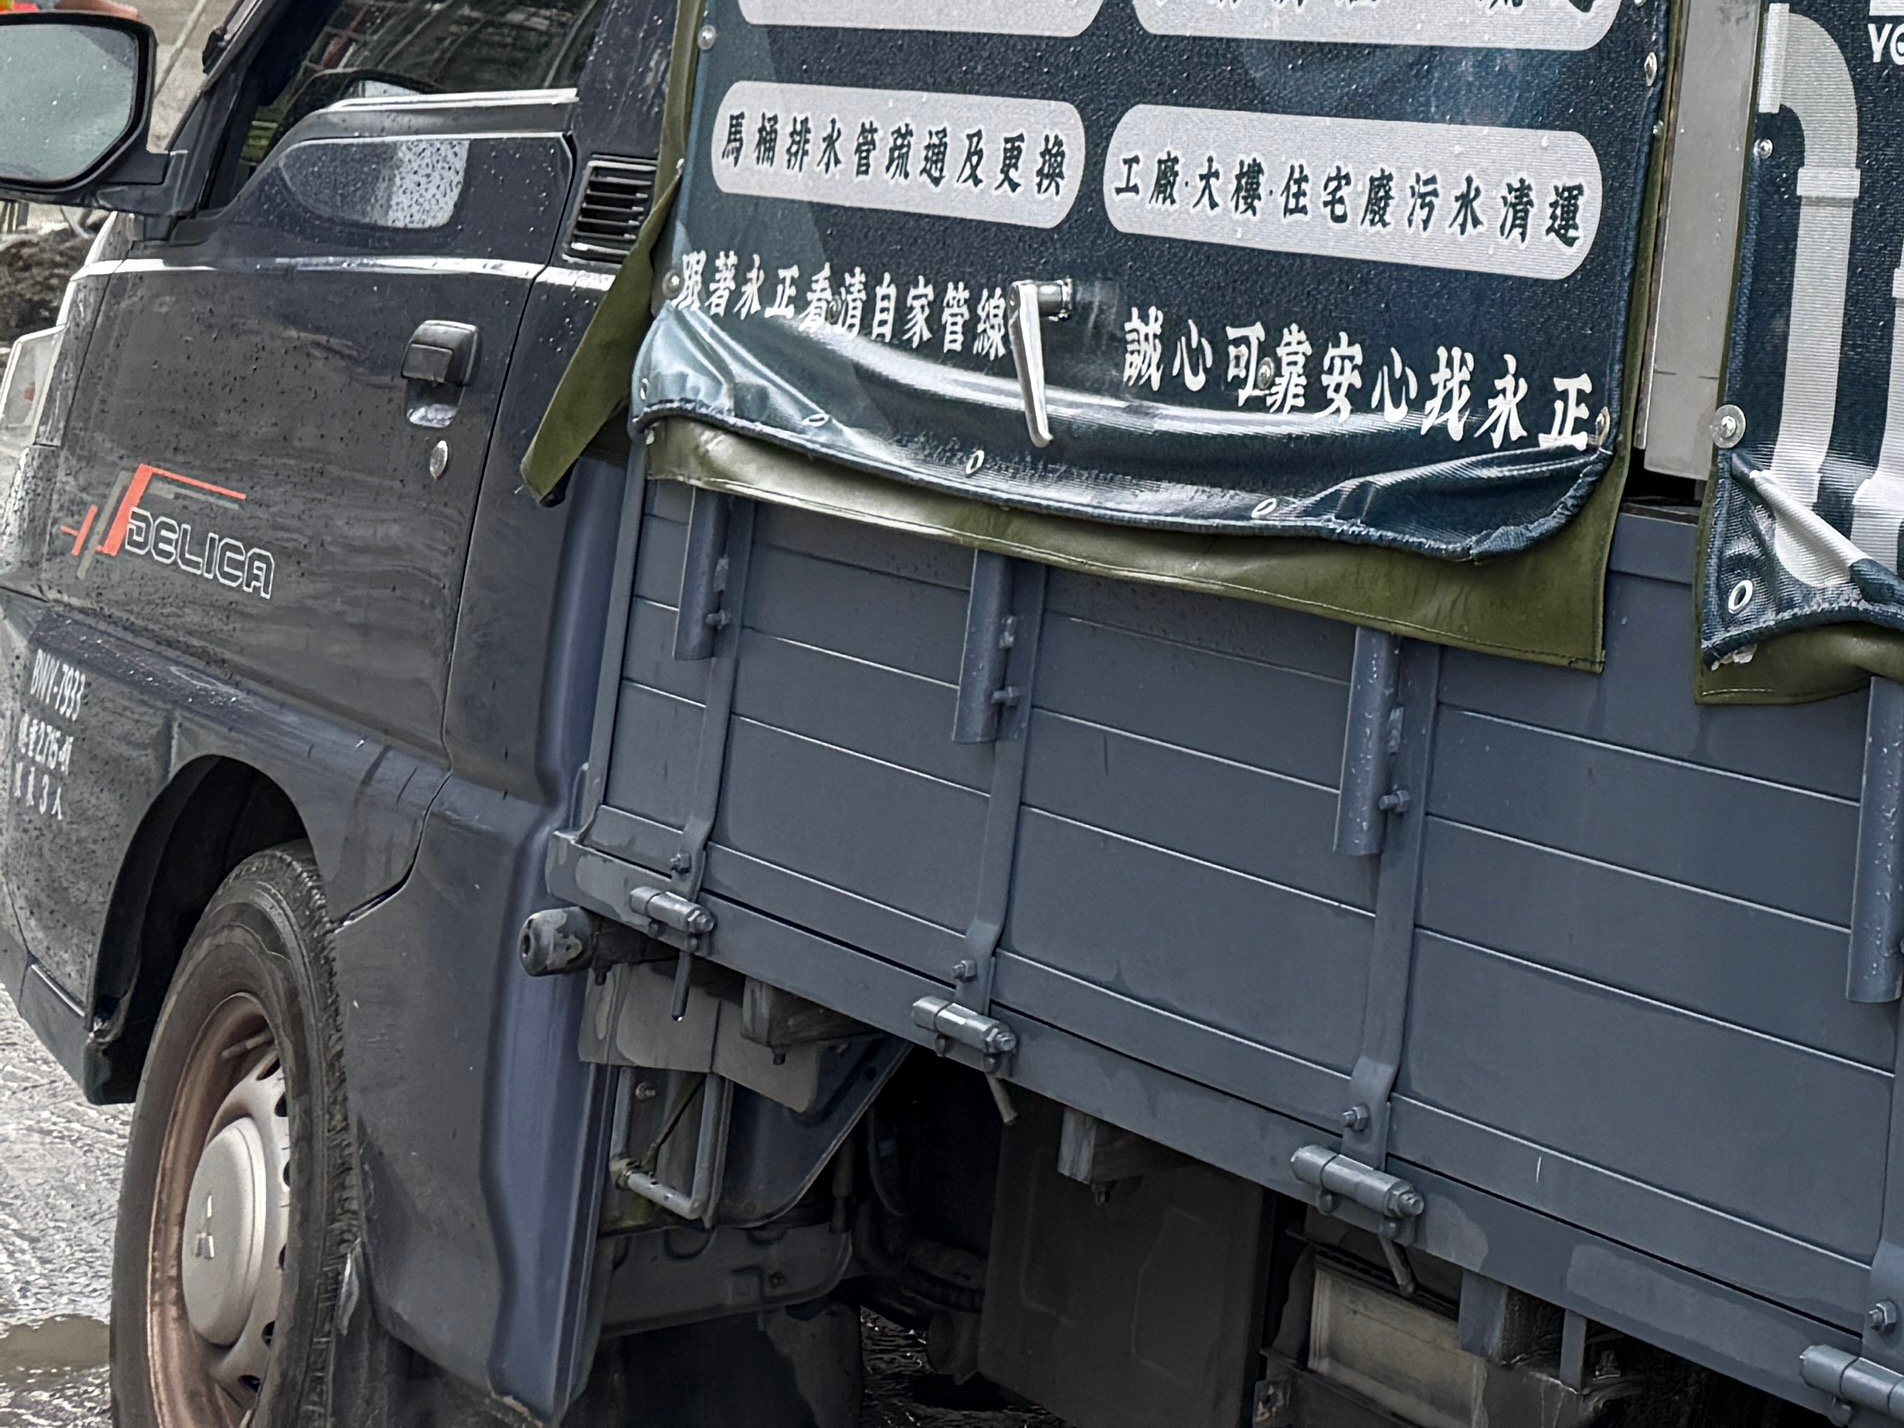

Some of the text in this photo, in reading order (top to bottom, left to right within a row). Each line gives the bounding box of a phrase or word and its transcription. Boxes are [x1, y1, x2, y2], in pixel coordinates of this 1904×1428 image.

[721, 111, 1067, 198] 馬桶排水管疏通及更換
[125, 506, 275, 600] DELICA
